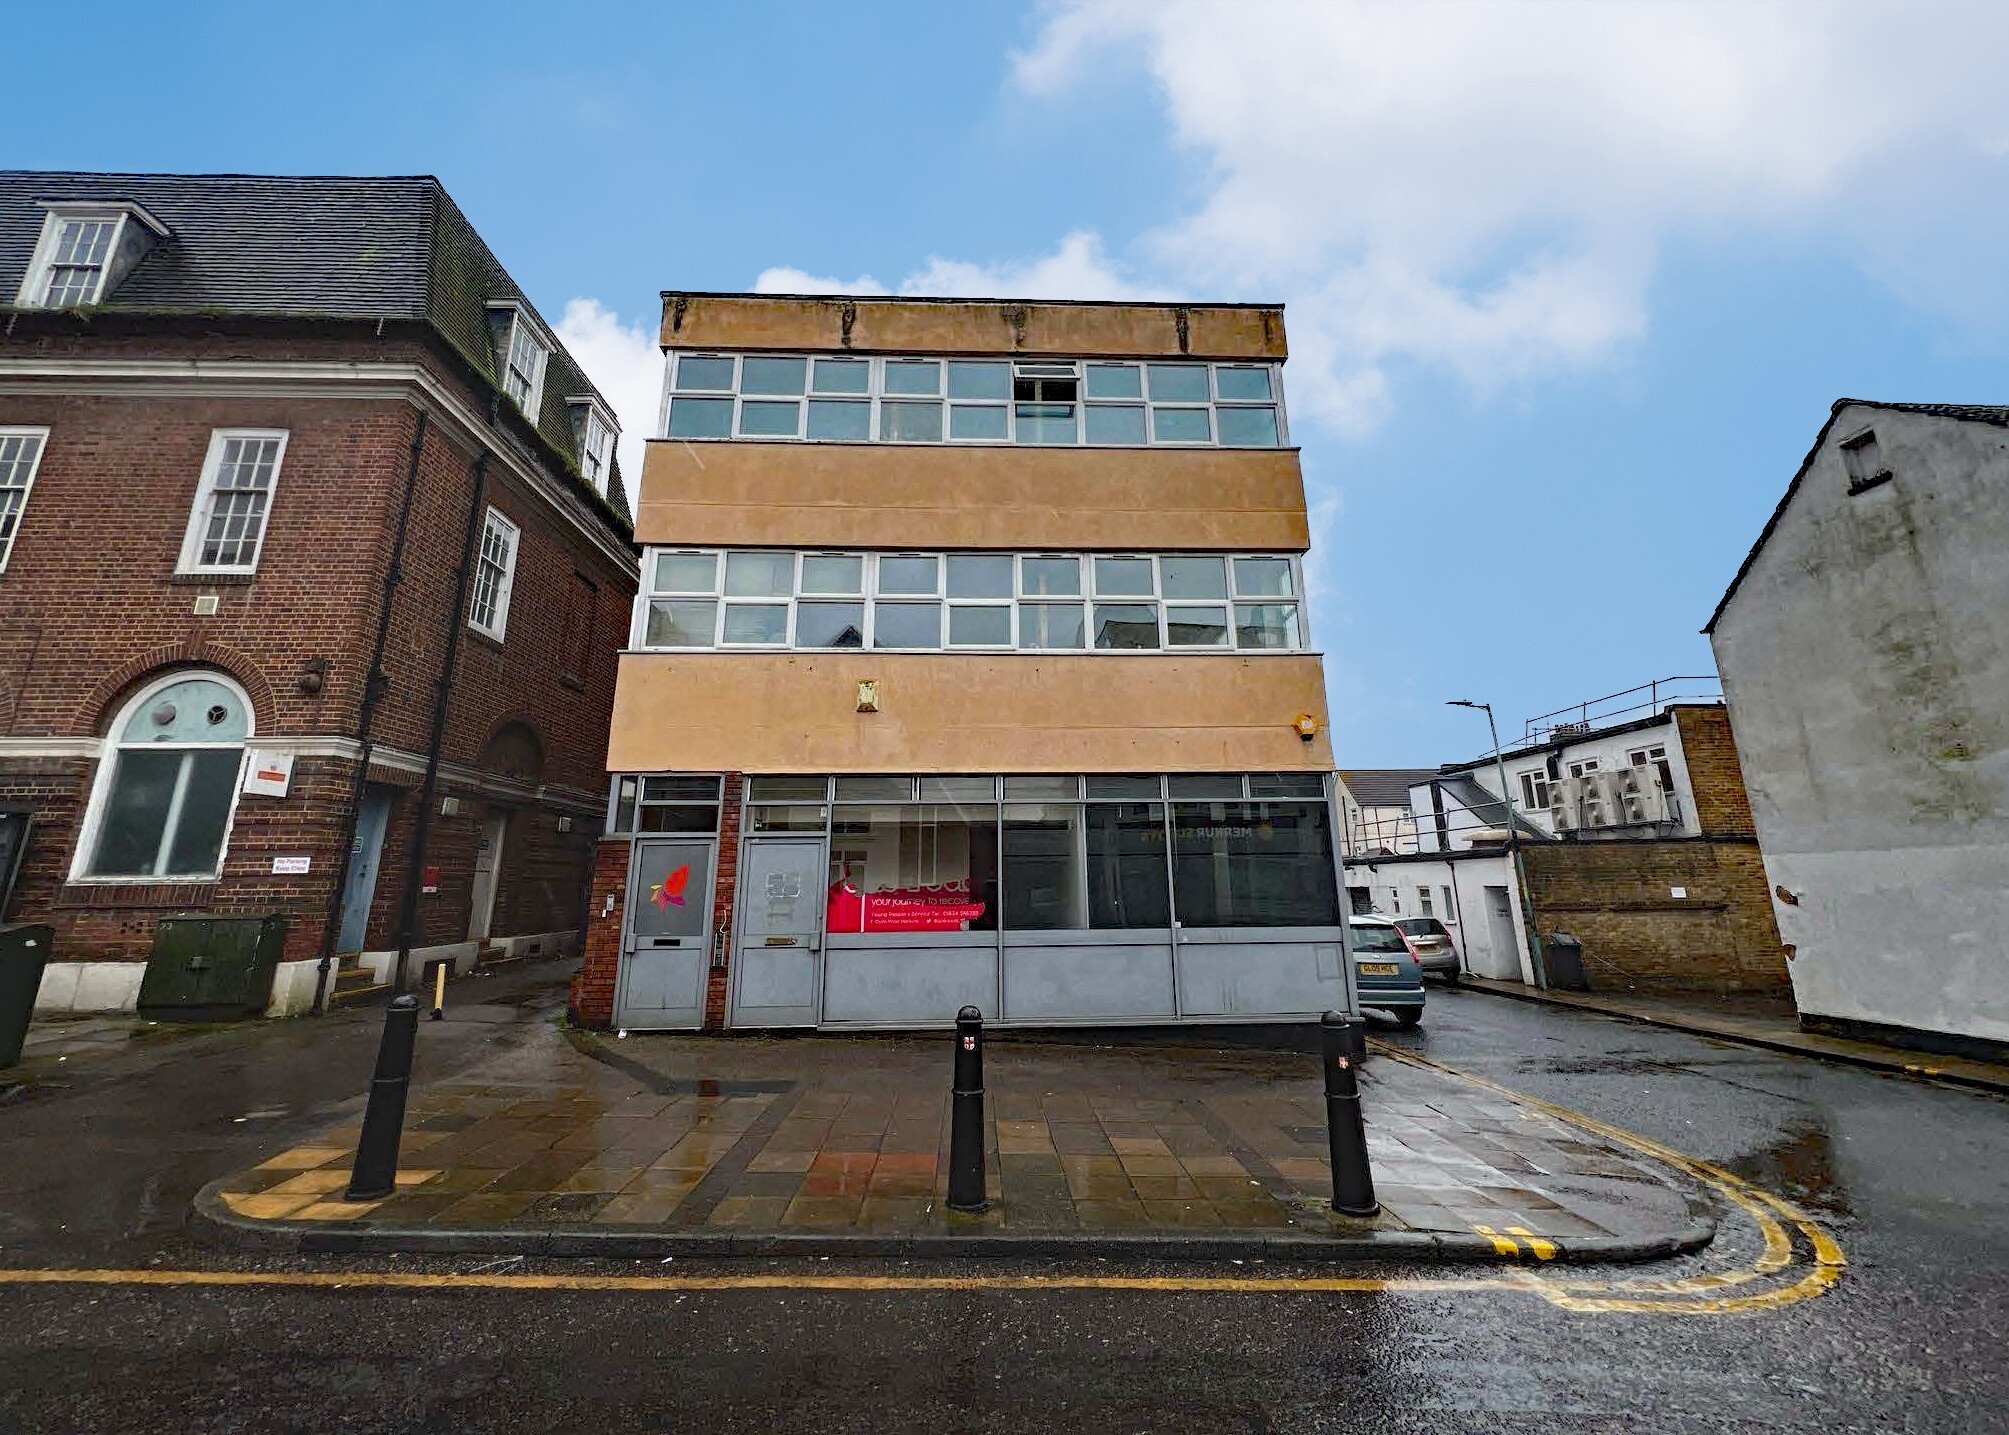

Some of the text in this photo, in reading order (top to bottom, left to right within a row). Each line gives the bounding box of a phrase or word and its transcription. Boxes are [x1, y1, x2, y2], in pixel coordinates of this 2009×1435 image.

[871, 898, 891, 907] your
[891, 898, 926, 907] journey
[928, 897, 937, 905] to
